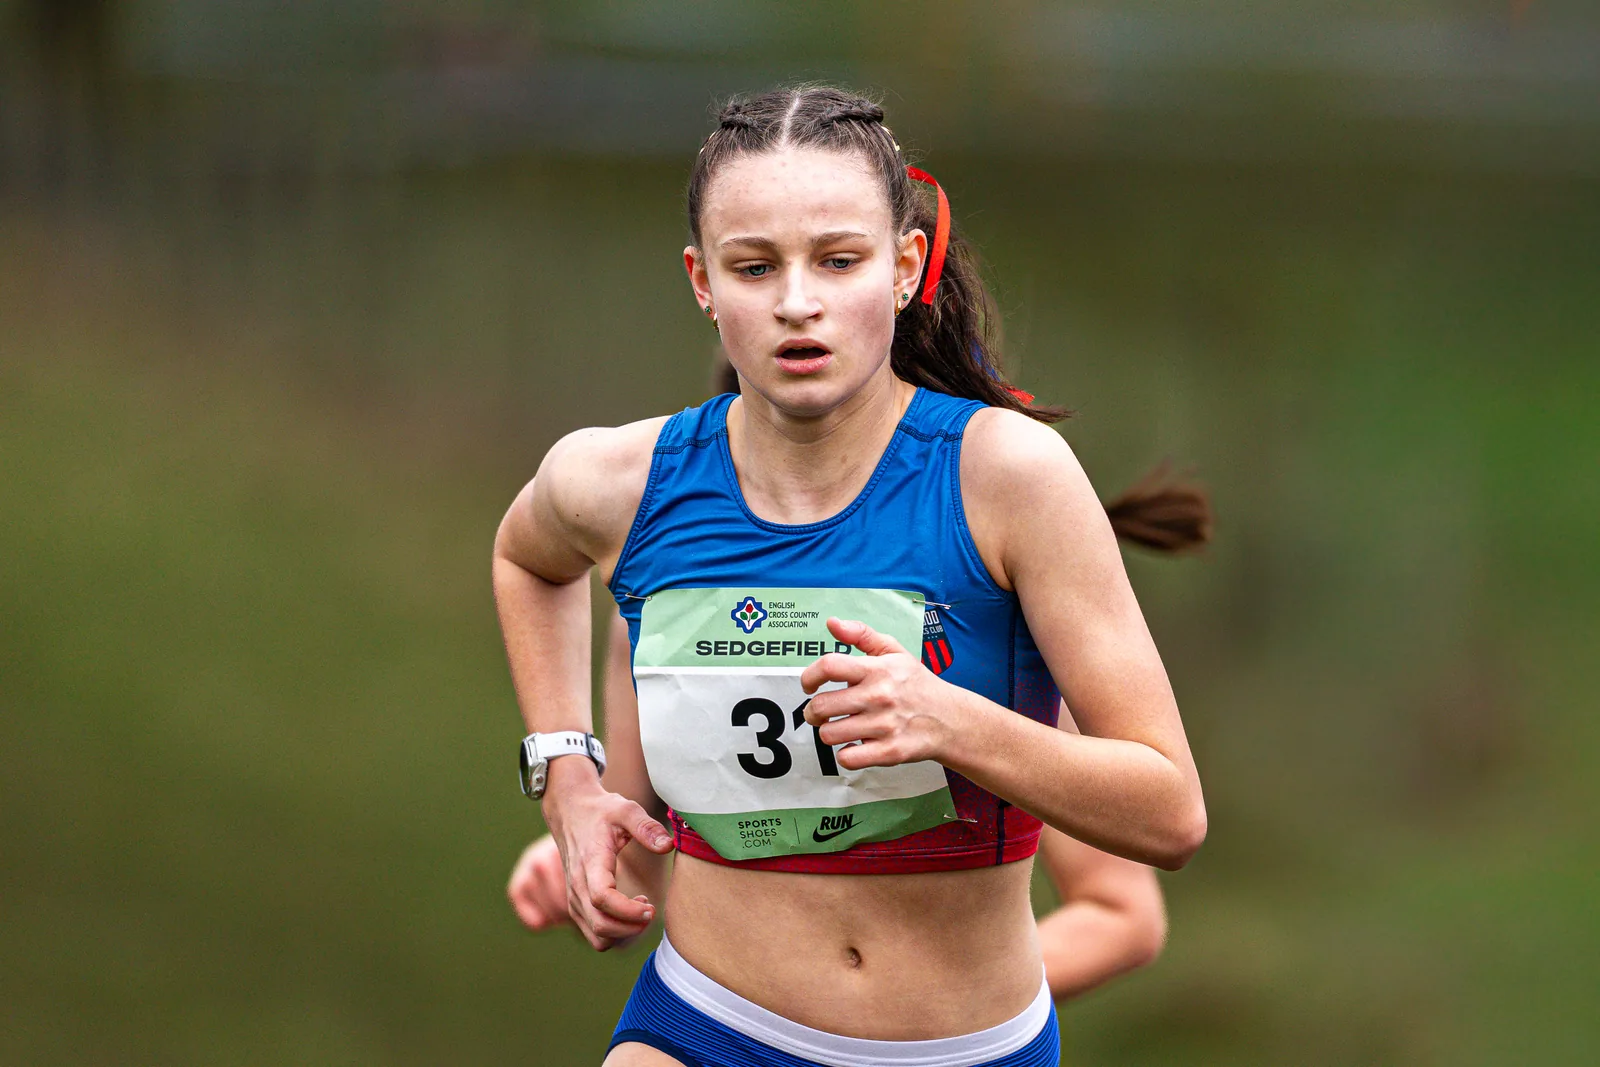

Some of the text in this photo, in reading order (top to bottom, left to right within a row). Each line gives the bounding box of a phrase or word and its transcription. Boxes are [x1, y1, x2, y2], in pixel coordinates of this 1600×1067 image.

[768, 611, 820, 619] CROSS COUNTRY
[930, 625, 943, 634] CLUB
[696, 640, 852, 656] SEDGEFIELD
[731, 697, 840, 779] 31
[738, 818, 782, 829] SPORTS
[819, 813, 854, 831] RUN
[740, 828, 777, 839] SHOES
[742, 838, 772, 849] .COM
